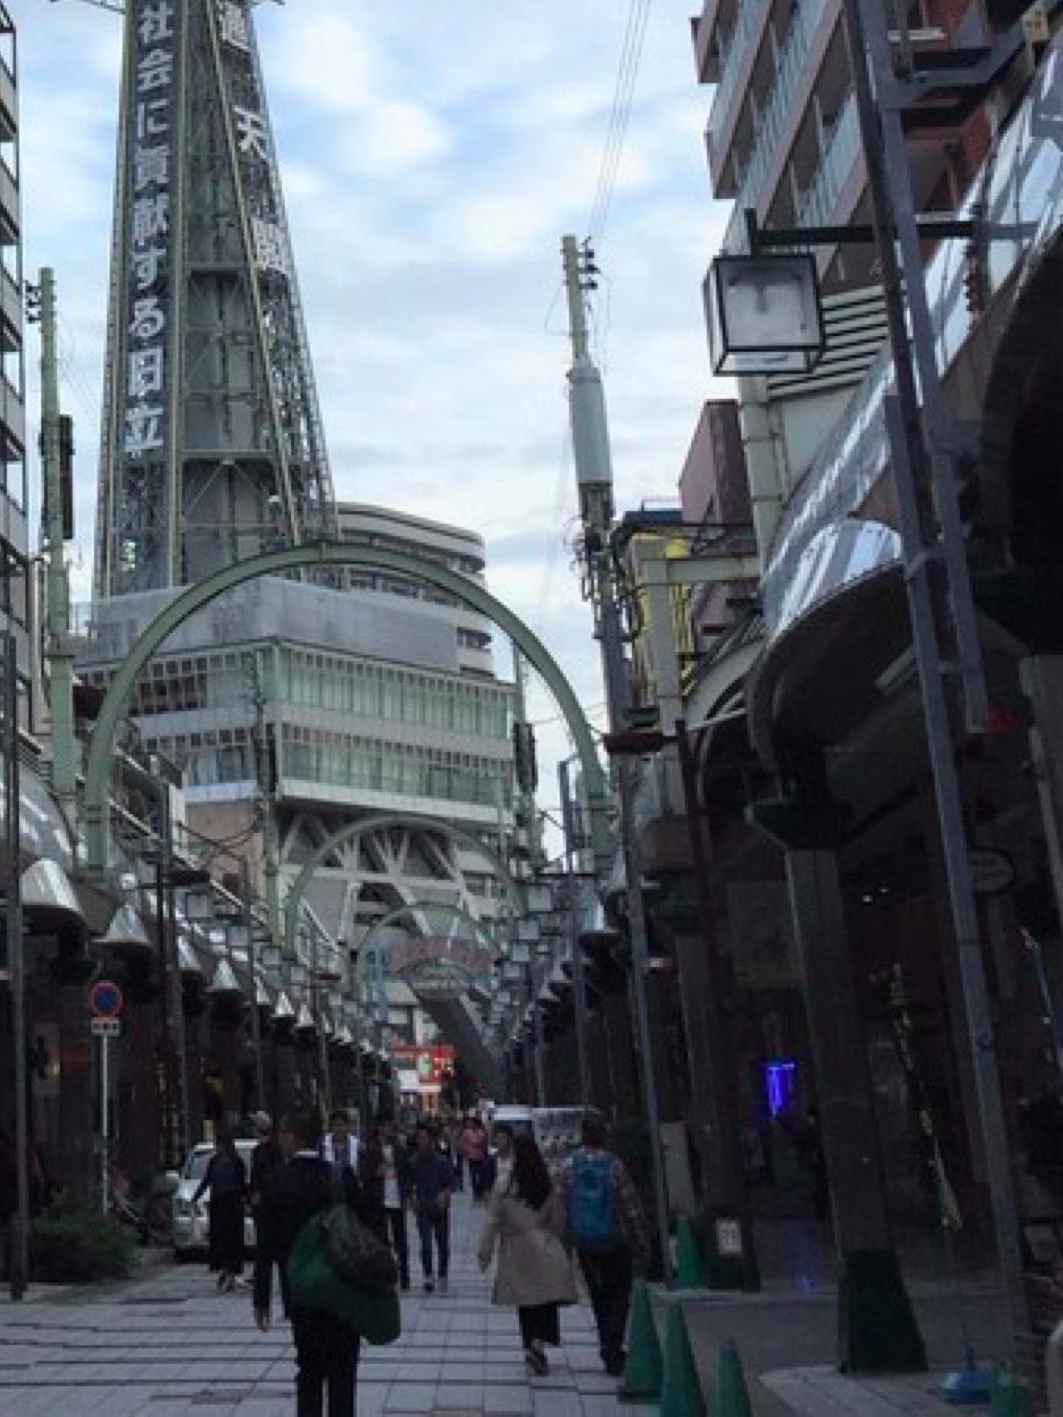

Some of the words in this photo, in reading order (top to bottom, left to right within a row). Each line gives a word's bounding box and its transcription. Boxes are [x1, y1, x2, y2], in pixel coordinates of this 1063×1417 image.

[125, 1, 175, 454] 社会に貢献する日立
[214, 0, 290, 276] 通天閣
